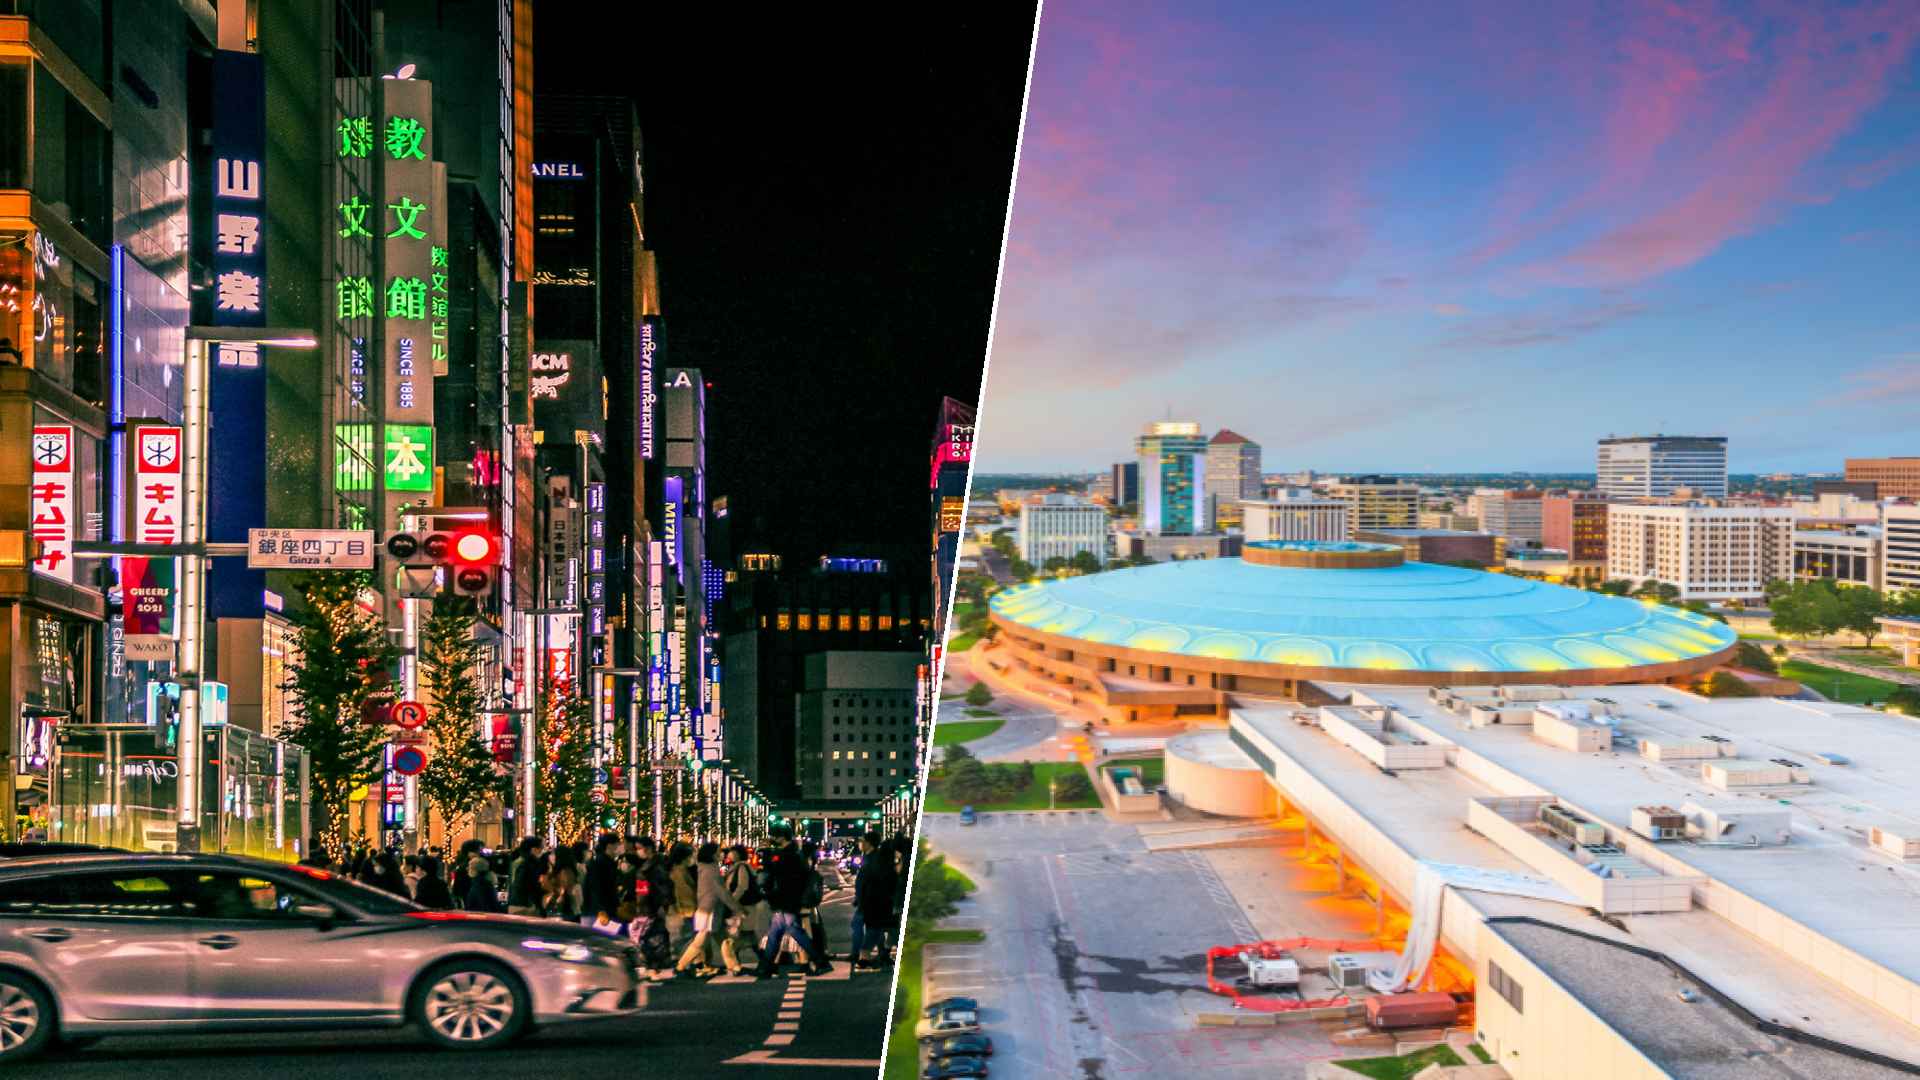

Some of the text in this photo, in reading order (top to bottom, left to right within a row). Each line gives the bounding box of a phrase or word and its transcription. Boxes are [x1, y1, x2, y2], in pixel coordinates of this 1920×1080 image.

[531, 163, 583, 176] ANEL
[384, 116, 427, 320] 教文館
[400, 338, 413, 408] SINCE 1885
[386, 436, 426, 480] 本
[145, 483, 175, 545] キムラ
[258, 530, 292, 539] 中央区
[258, 539, 364, 555] 銀座四丁目
[288, 556, 320, 564] Ginza
[130, 587, 169, 596] CHEERS
[137, 604, 163, 612] 2021
[133, 643, 168, 652] WAKO
